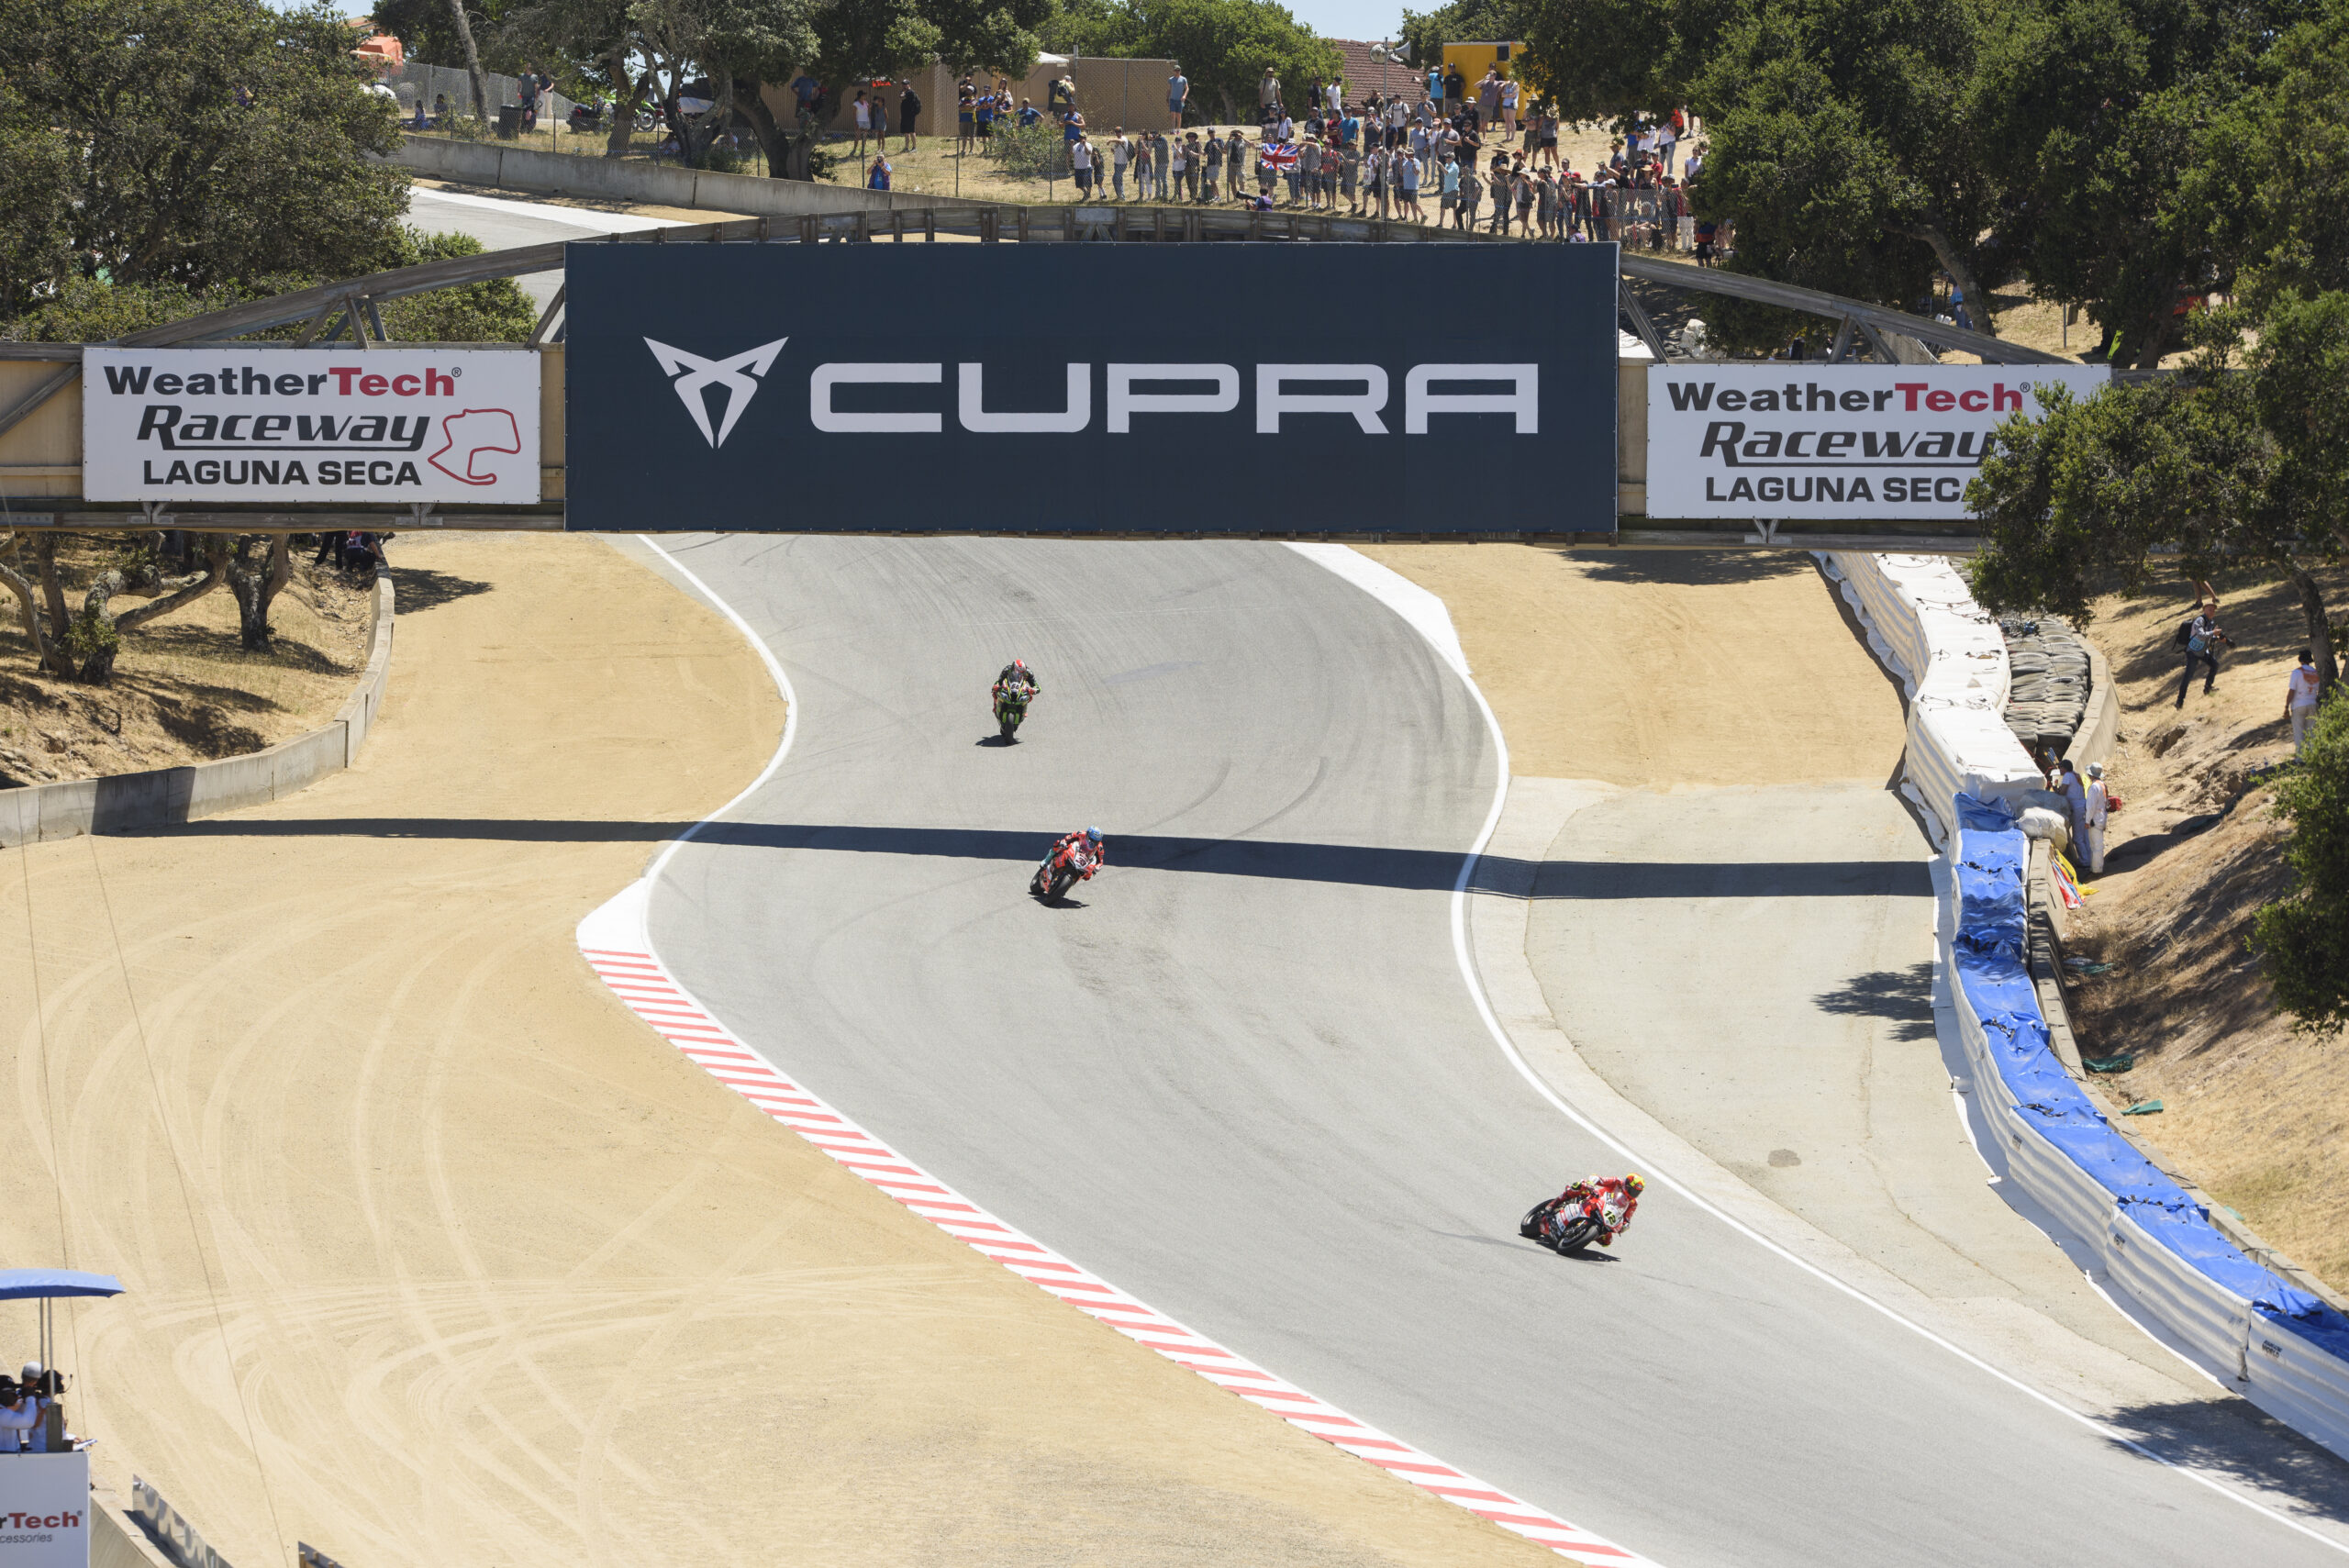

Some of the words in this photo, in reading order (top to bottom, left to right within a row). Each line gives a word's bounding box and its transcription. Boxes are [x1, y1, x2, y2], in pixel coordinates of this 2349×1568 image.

[810, 362, 1539, 434] CUPRA
[137, 405, 431, 452] Raceway
[143, 460, 310, 485] LAGUNA
[317, 460, 422, 486] SECA
[1706, 476, 1875, 503] LAGUNA
[1604, 1210, 1617, 1225] 12
